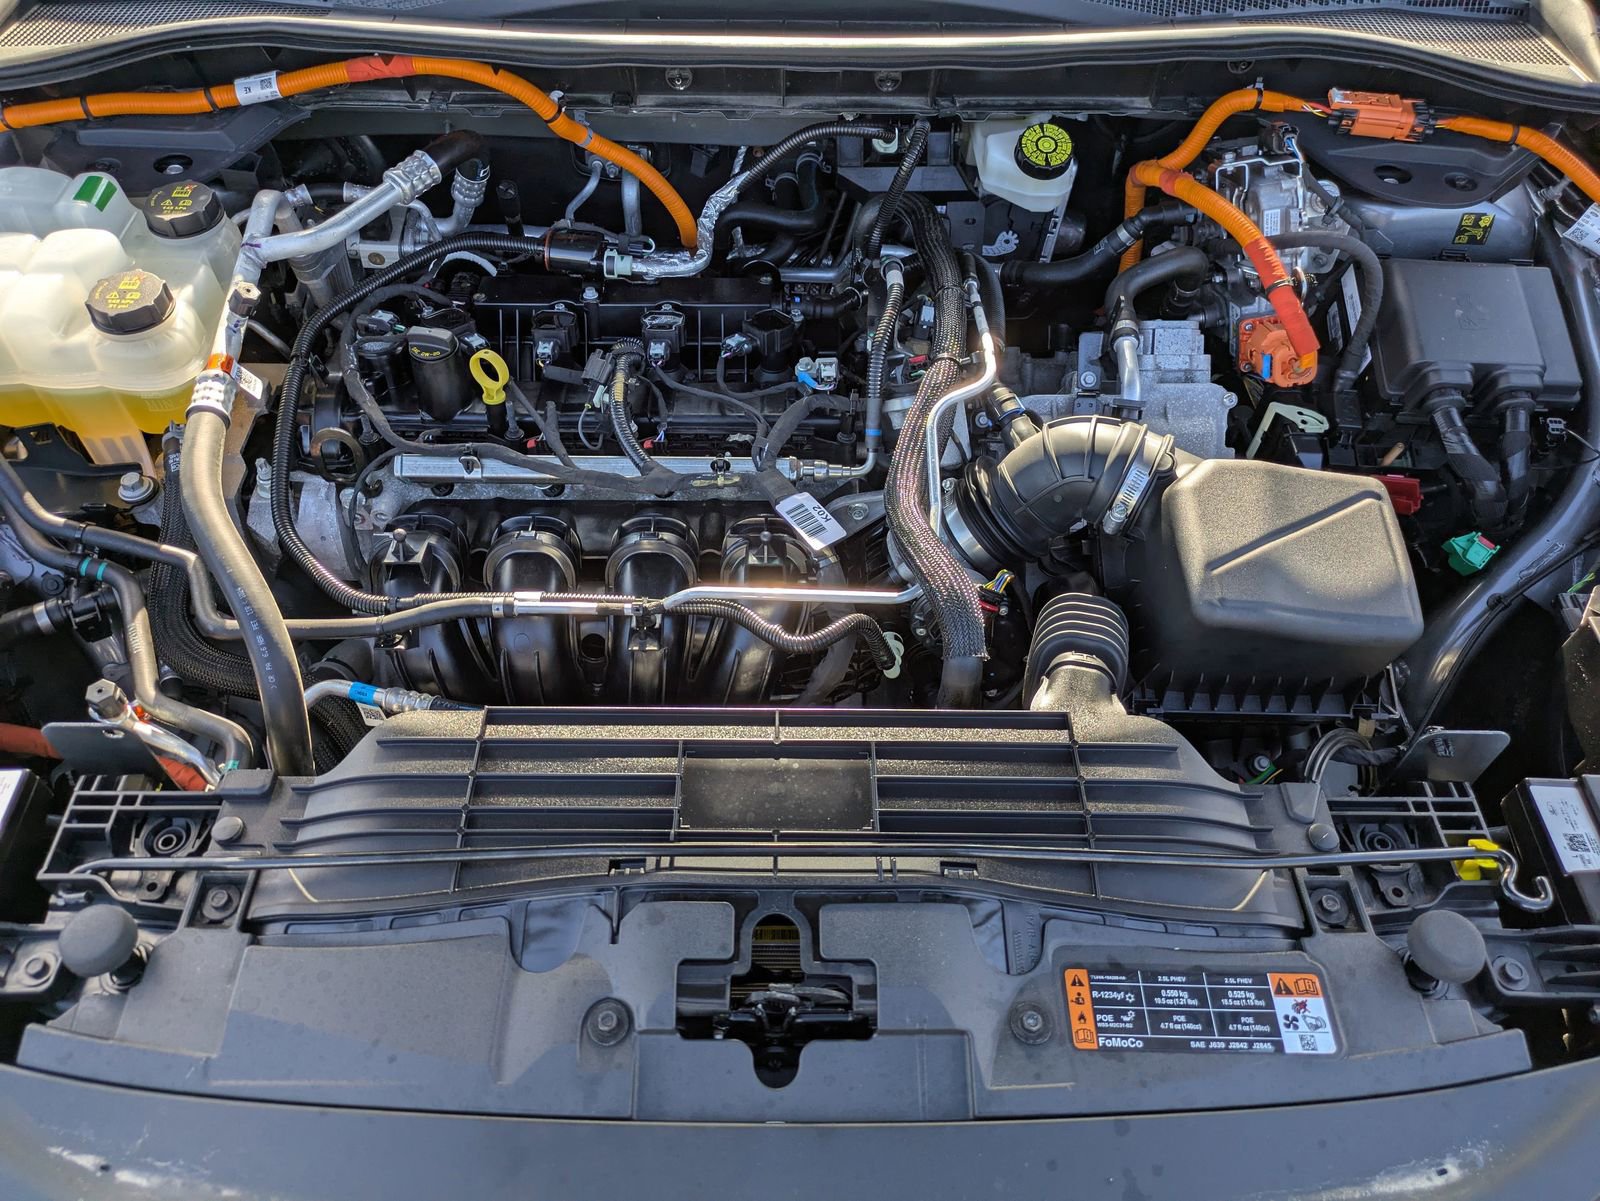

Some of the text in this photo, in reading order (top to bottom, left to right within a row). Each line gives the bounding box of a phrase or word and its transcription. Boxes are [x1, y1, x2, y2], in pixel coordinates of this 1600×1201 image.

[244, 86, 252, 94] KE
[812, 504, 832, 522] K02
[1092, 991, 1125, 1000] R-1234yf
[1179, 990, 1188, 998] kg
[1246, 991, 1255, 999] kg
[1098, 1038, 1144, 1048] FoMoCo
